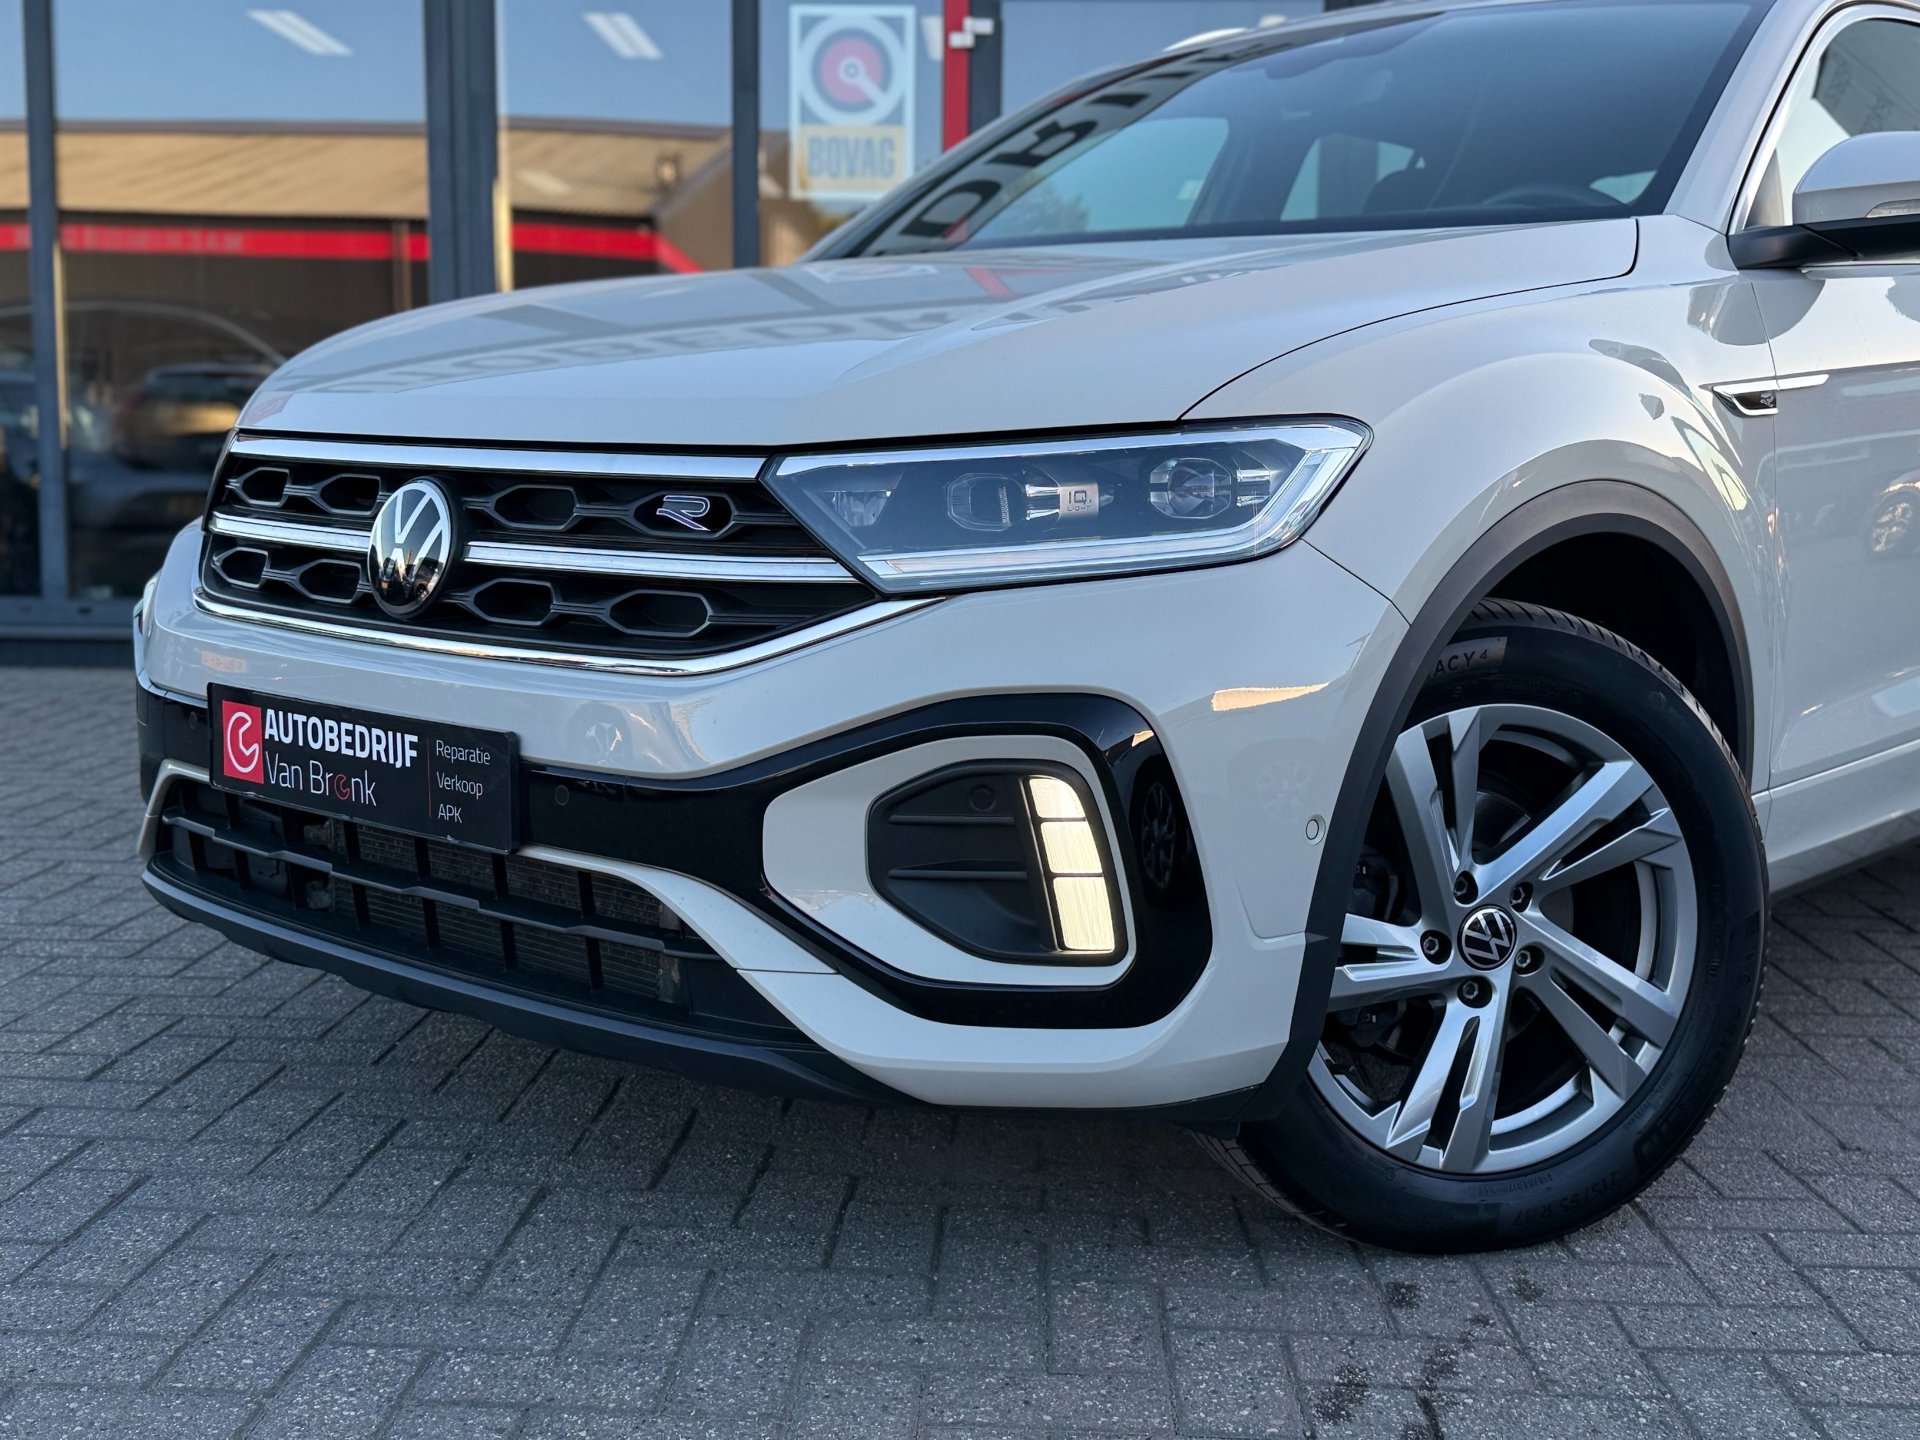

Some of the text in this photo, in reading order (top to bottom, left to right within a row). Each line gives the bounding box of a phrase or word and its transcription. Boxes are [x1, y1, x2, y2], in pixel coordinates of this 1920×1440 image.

[808, 135, 895, 179] BOVAG
[656, 494, 711, 532] R
[1429, 651, 1476, 677] ACY
[265, 708, 418, 768] AUTOBEDRIJF
[436, 739, 491, 765] Reparatie
[265, 751, 303, 790] Van
[436, 771, 484, 800] Verkoop
[437, 803, 463, 824] APK
